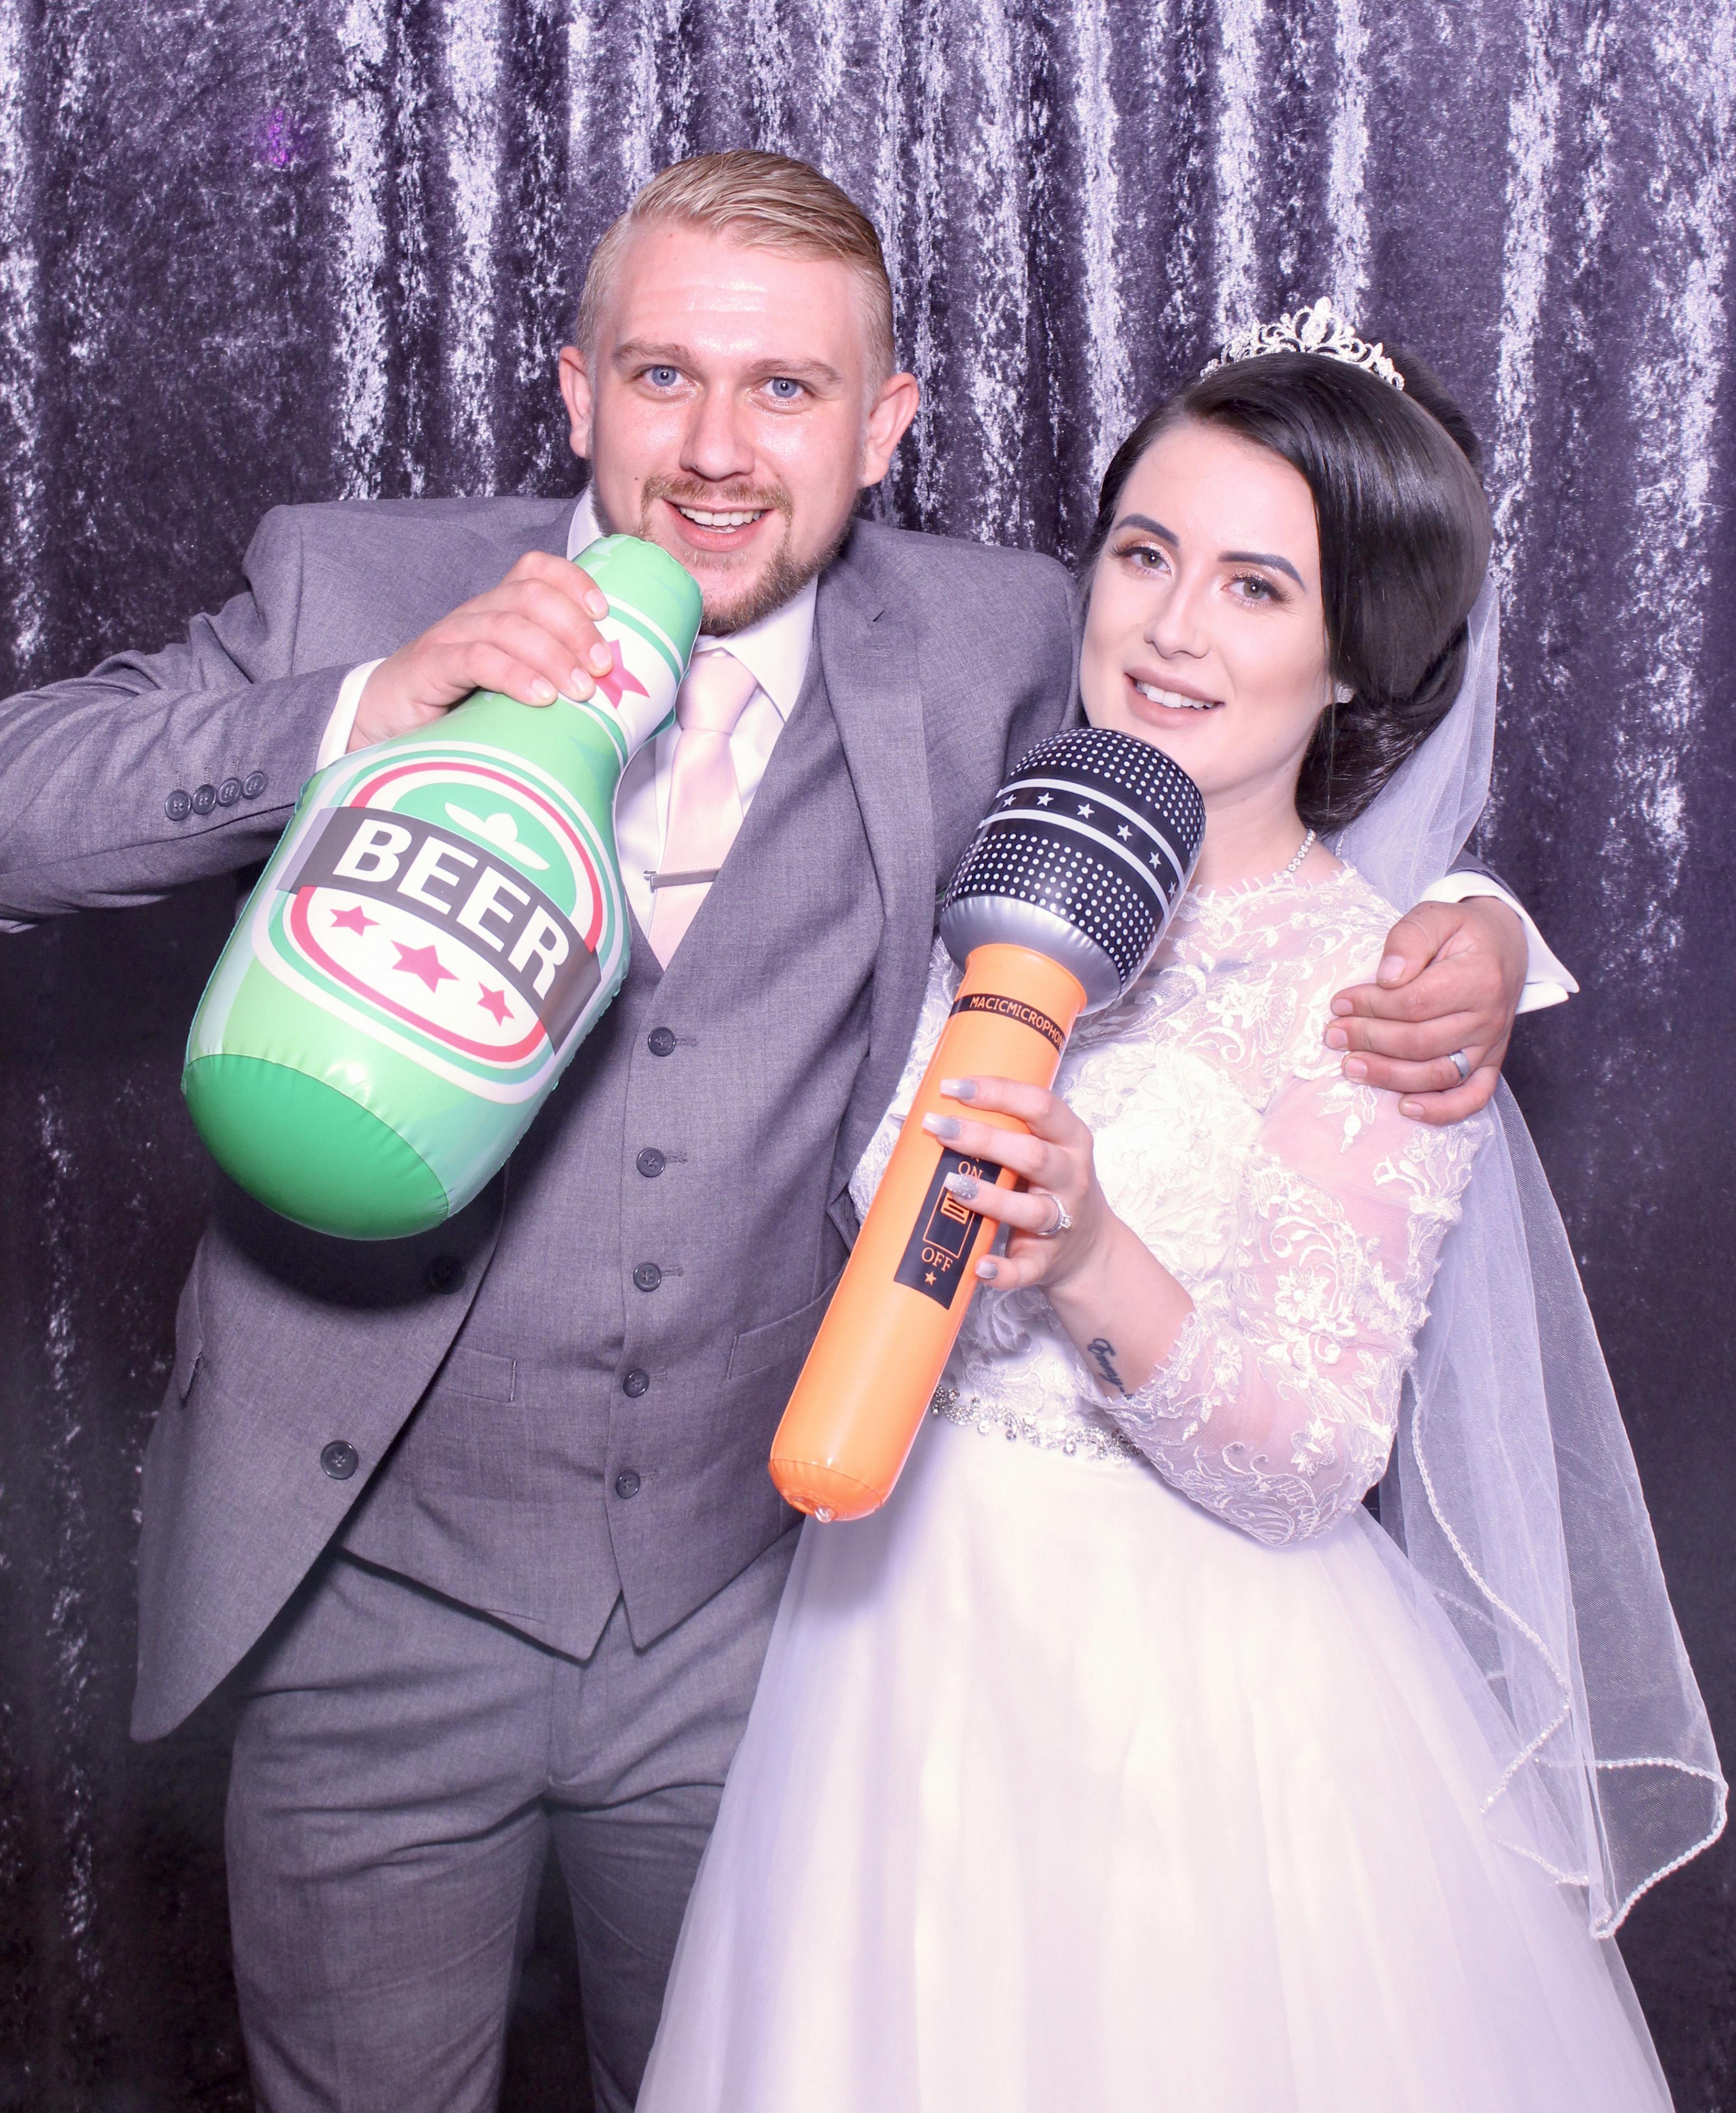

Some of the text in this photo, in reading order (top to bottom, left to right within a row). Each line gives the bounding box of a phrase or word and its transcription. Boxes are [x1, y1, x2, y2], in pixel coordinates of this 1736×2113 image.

[332, 818, 569, 1001] BEER
[958, 1161, 983, 1179] ON
[921, 1247, 953, 1273] OFF
